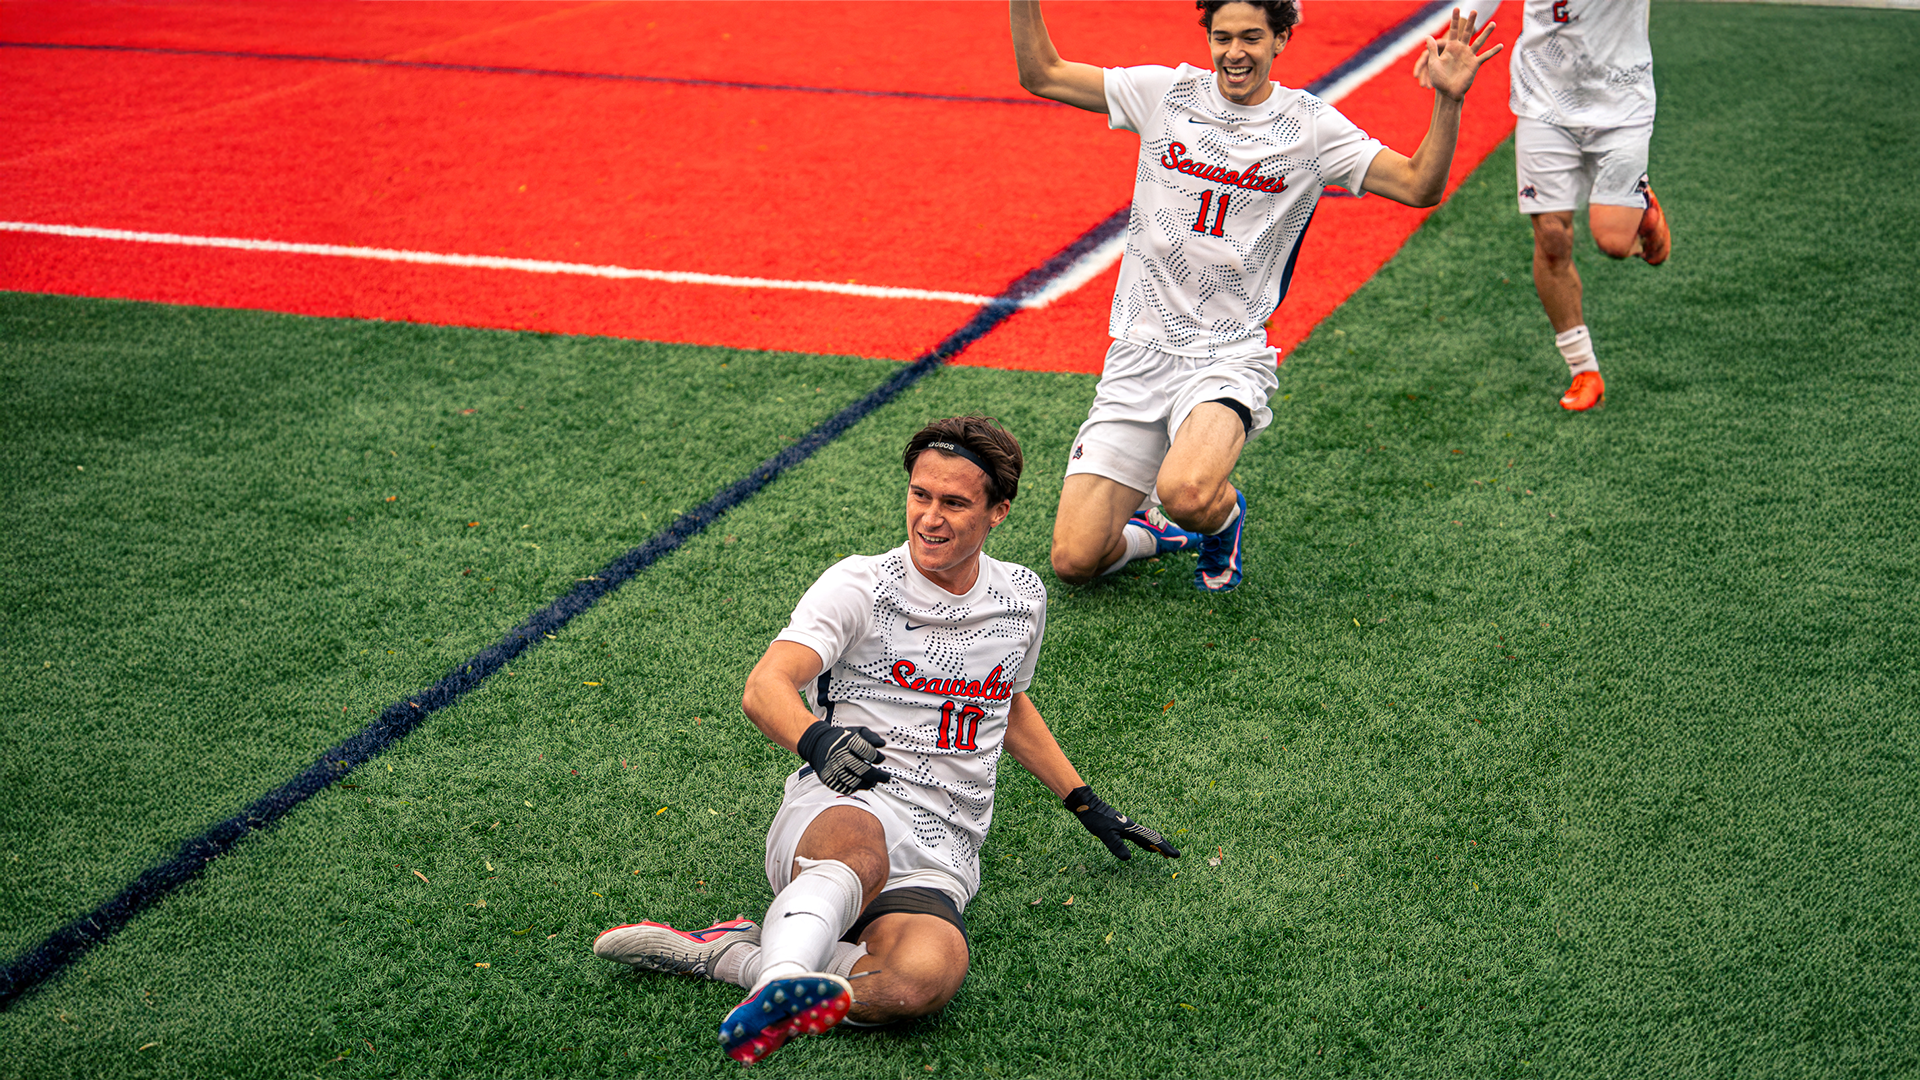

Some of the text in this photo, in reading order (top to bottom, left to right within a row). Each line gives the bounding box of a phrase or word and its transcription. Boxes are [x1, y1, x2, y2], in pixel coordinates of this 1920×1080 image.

[1161, 141, 1289, 193] Seawolves
[1191, 189, 1231, 238] 11
[936, 700, 985, 750] 10
